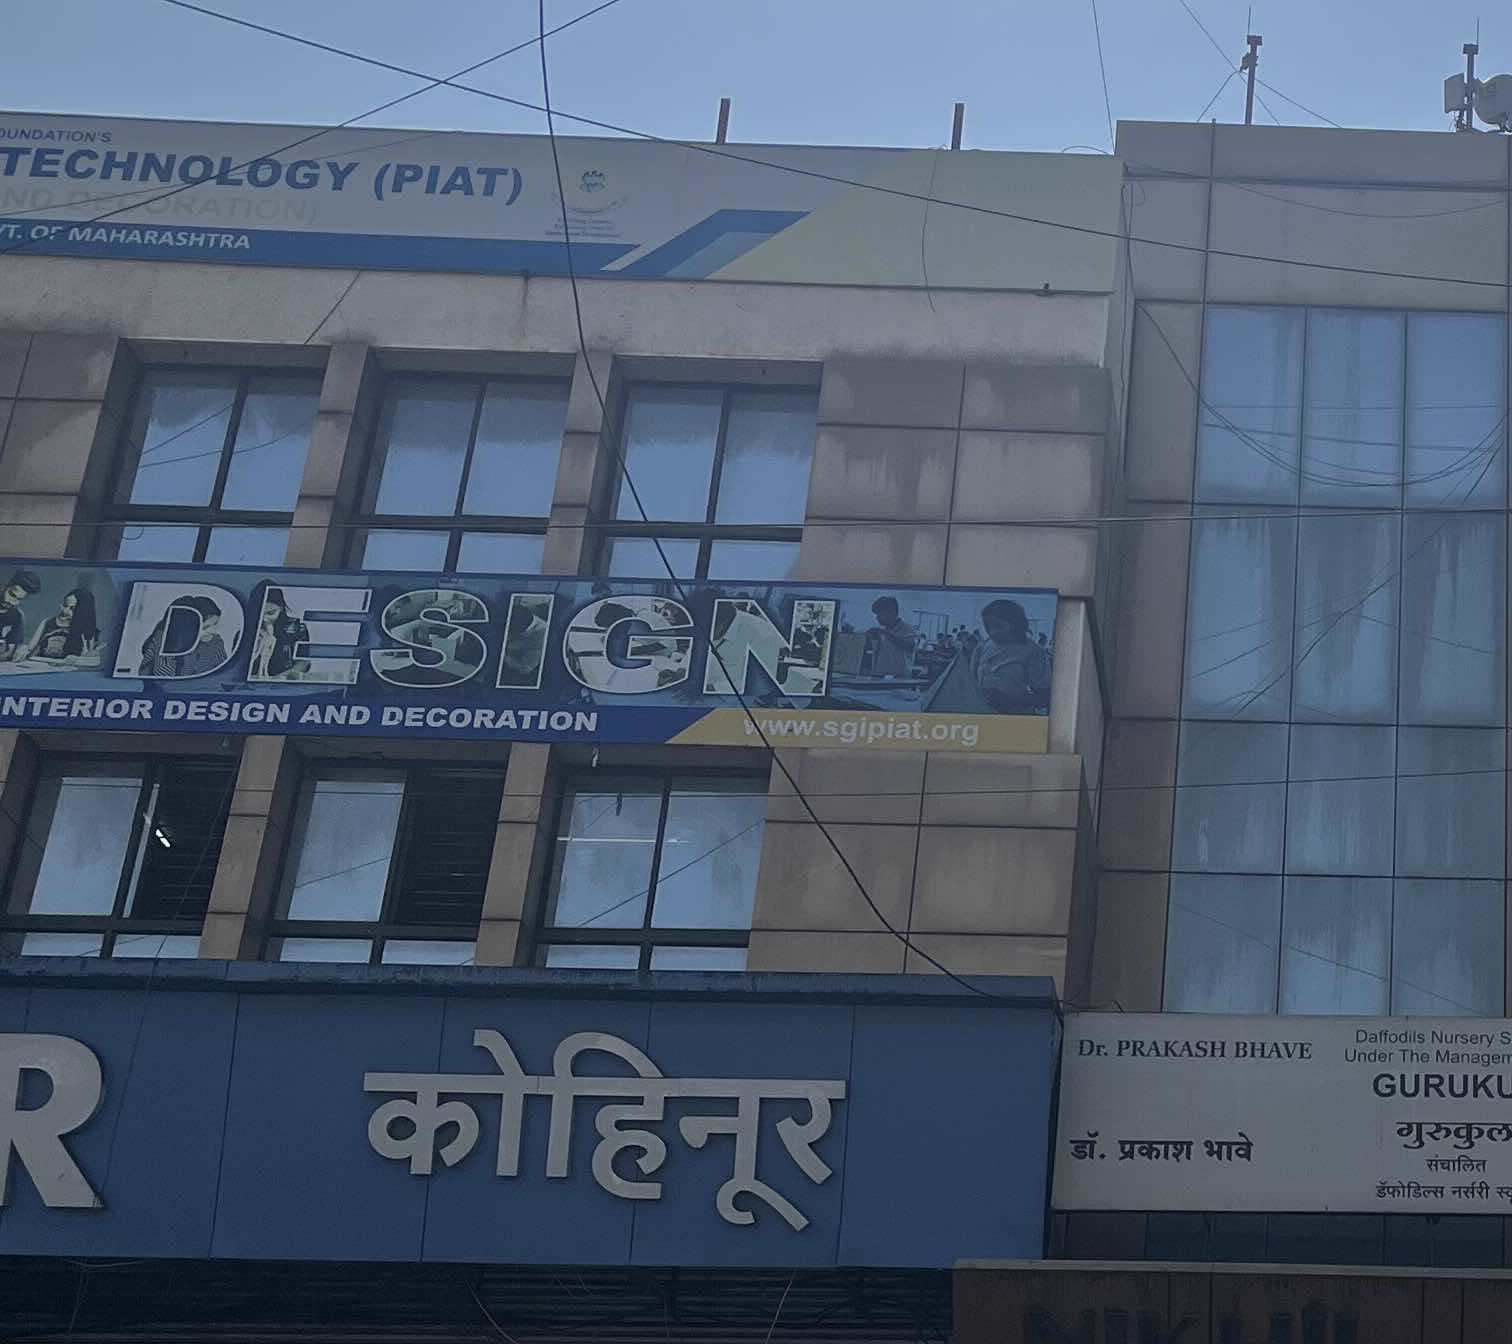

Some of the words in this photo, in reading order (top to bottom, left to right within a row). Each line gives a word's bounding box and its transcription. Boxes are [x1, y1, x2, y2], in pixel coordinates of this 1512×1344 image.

[0, 147, 360, 191] TECHNOLOGY
[373, 162, 522, 206] (PIAT)
[30, 225, 65, 240] OF
[68, 226, 251, 249] MAHARASHTRA
[113, 579, 836, 697] DESIGN
[0, 695, 153, 720] NTERIOR
[163, 700, 291, 724] DESIGN
[299, 703, 371, 727] AND
[381, 706, 598, 732] DECORATION
[744, 714, 980, 745] www.sgipiat.org
[1078, 1039, 1108, 1057] Dr.
[1117, 1038, 1227, 1058] PRAKASH
[1234, 1040, 1313, 1060] BHAVE
[1355, 1029, 1425, 1045] Daffodils
[1431, 1030, 1495, 1049] Nursery
[1344, 1049, 1394, 1064] Under
[1399, 1049, 1430, 1064] The
[364, 1028, 847, 1232] कोहिनूर
[1069, 1130, 1106, 1161] डॉ.
[1118, 1139, 1194, 1162] प्रकाश
[1203, 1131, 1254, 1162] भावे
[1425, 1154, 1488, 1174] संचालित
[1451, 1181, 1490, 1200] नर्सरी
